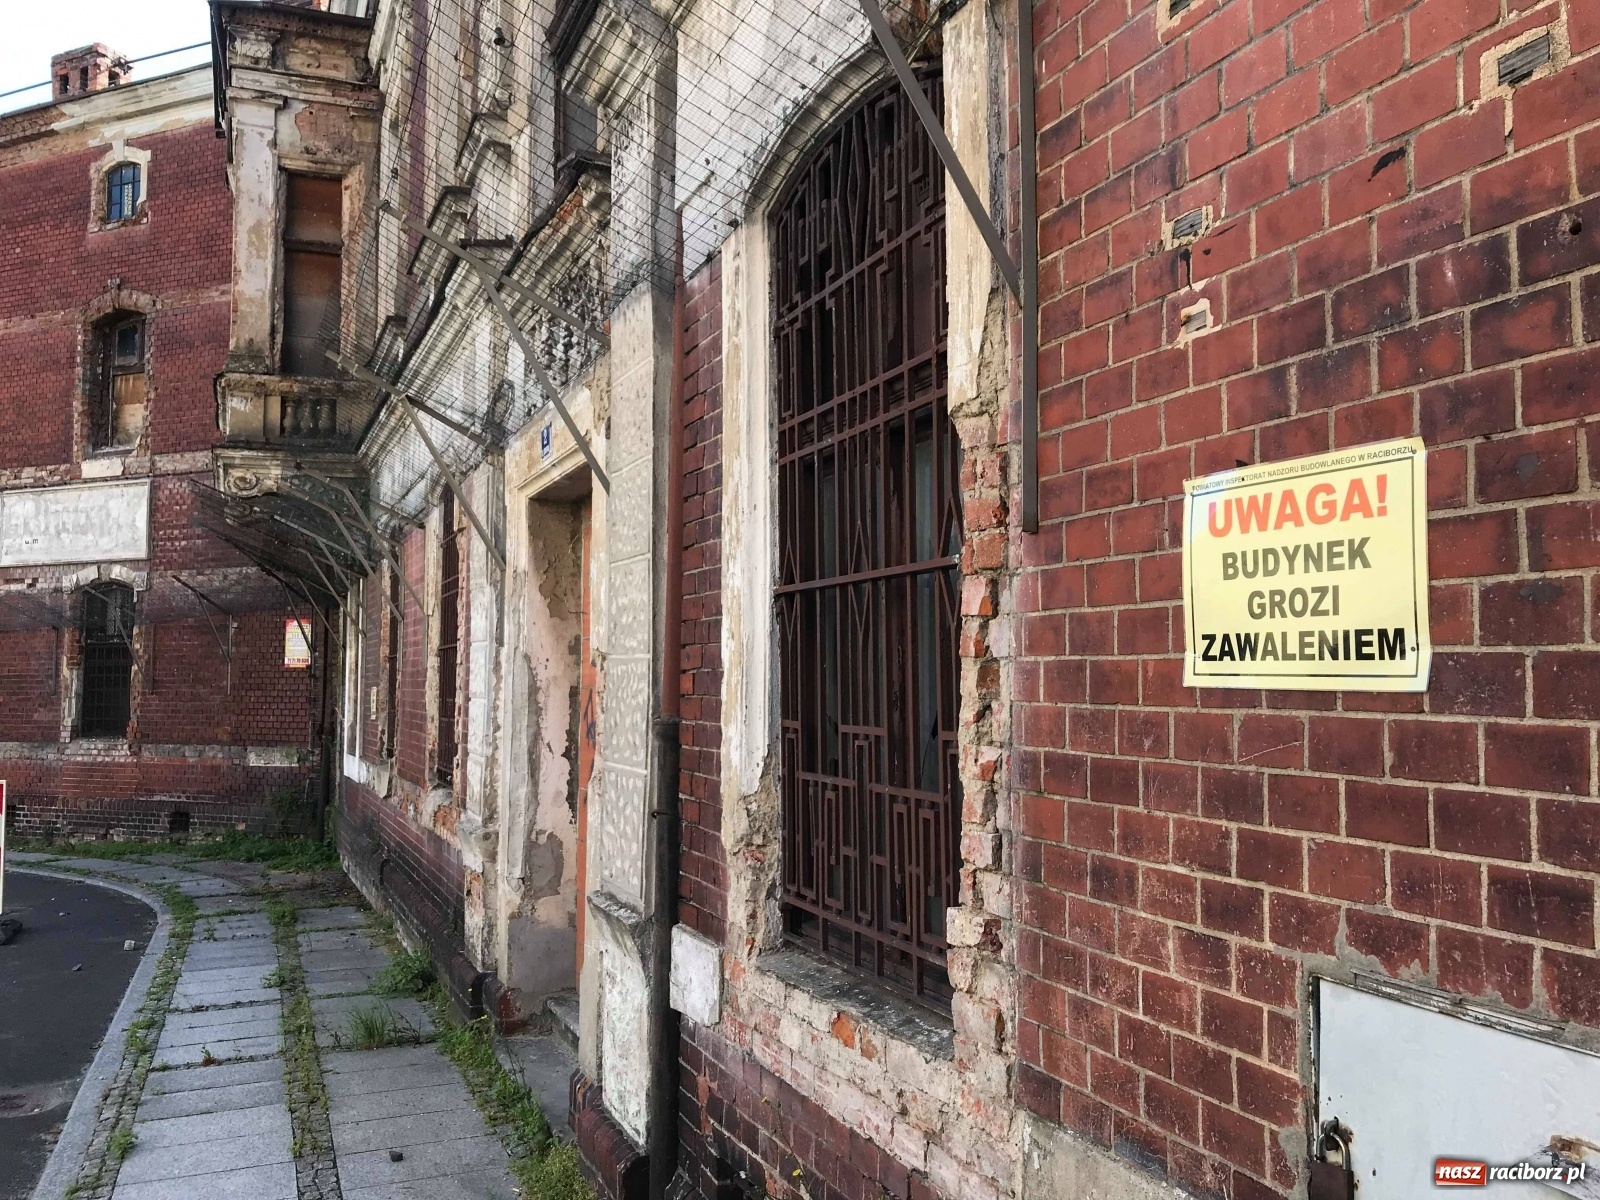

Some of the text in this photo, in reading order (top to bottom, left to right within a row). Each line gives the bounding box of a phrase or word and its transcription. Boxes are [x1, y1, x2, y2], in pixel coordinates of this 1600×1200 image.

[1192, 445, 1413, 491] POWIATOWY INSPEKTORAT NADZORU BUDOWLANEGO W RACIBORZU
[1208, 473, 1388, 538] UWAGA!
[1221, 536, 1372, 581] BUDYNEK
[1247, 584, 1340, 620] GROZI
[1201, 627, 1407, 662] ZAWALENIEM
